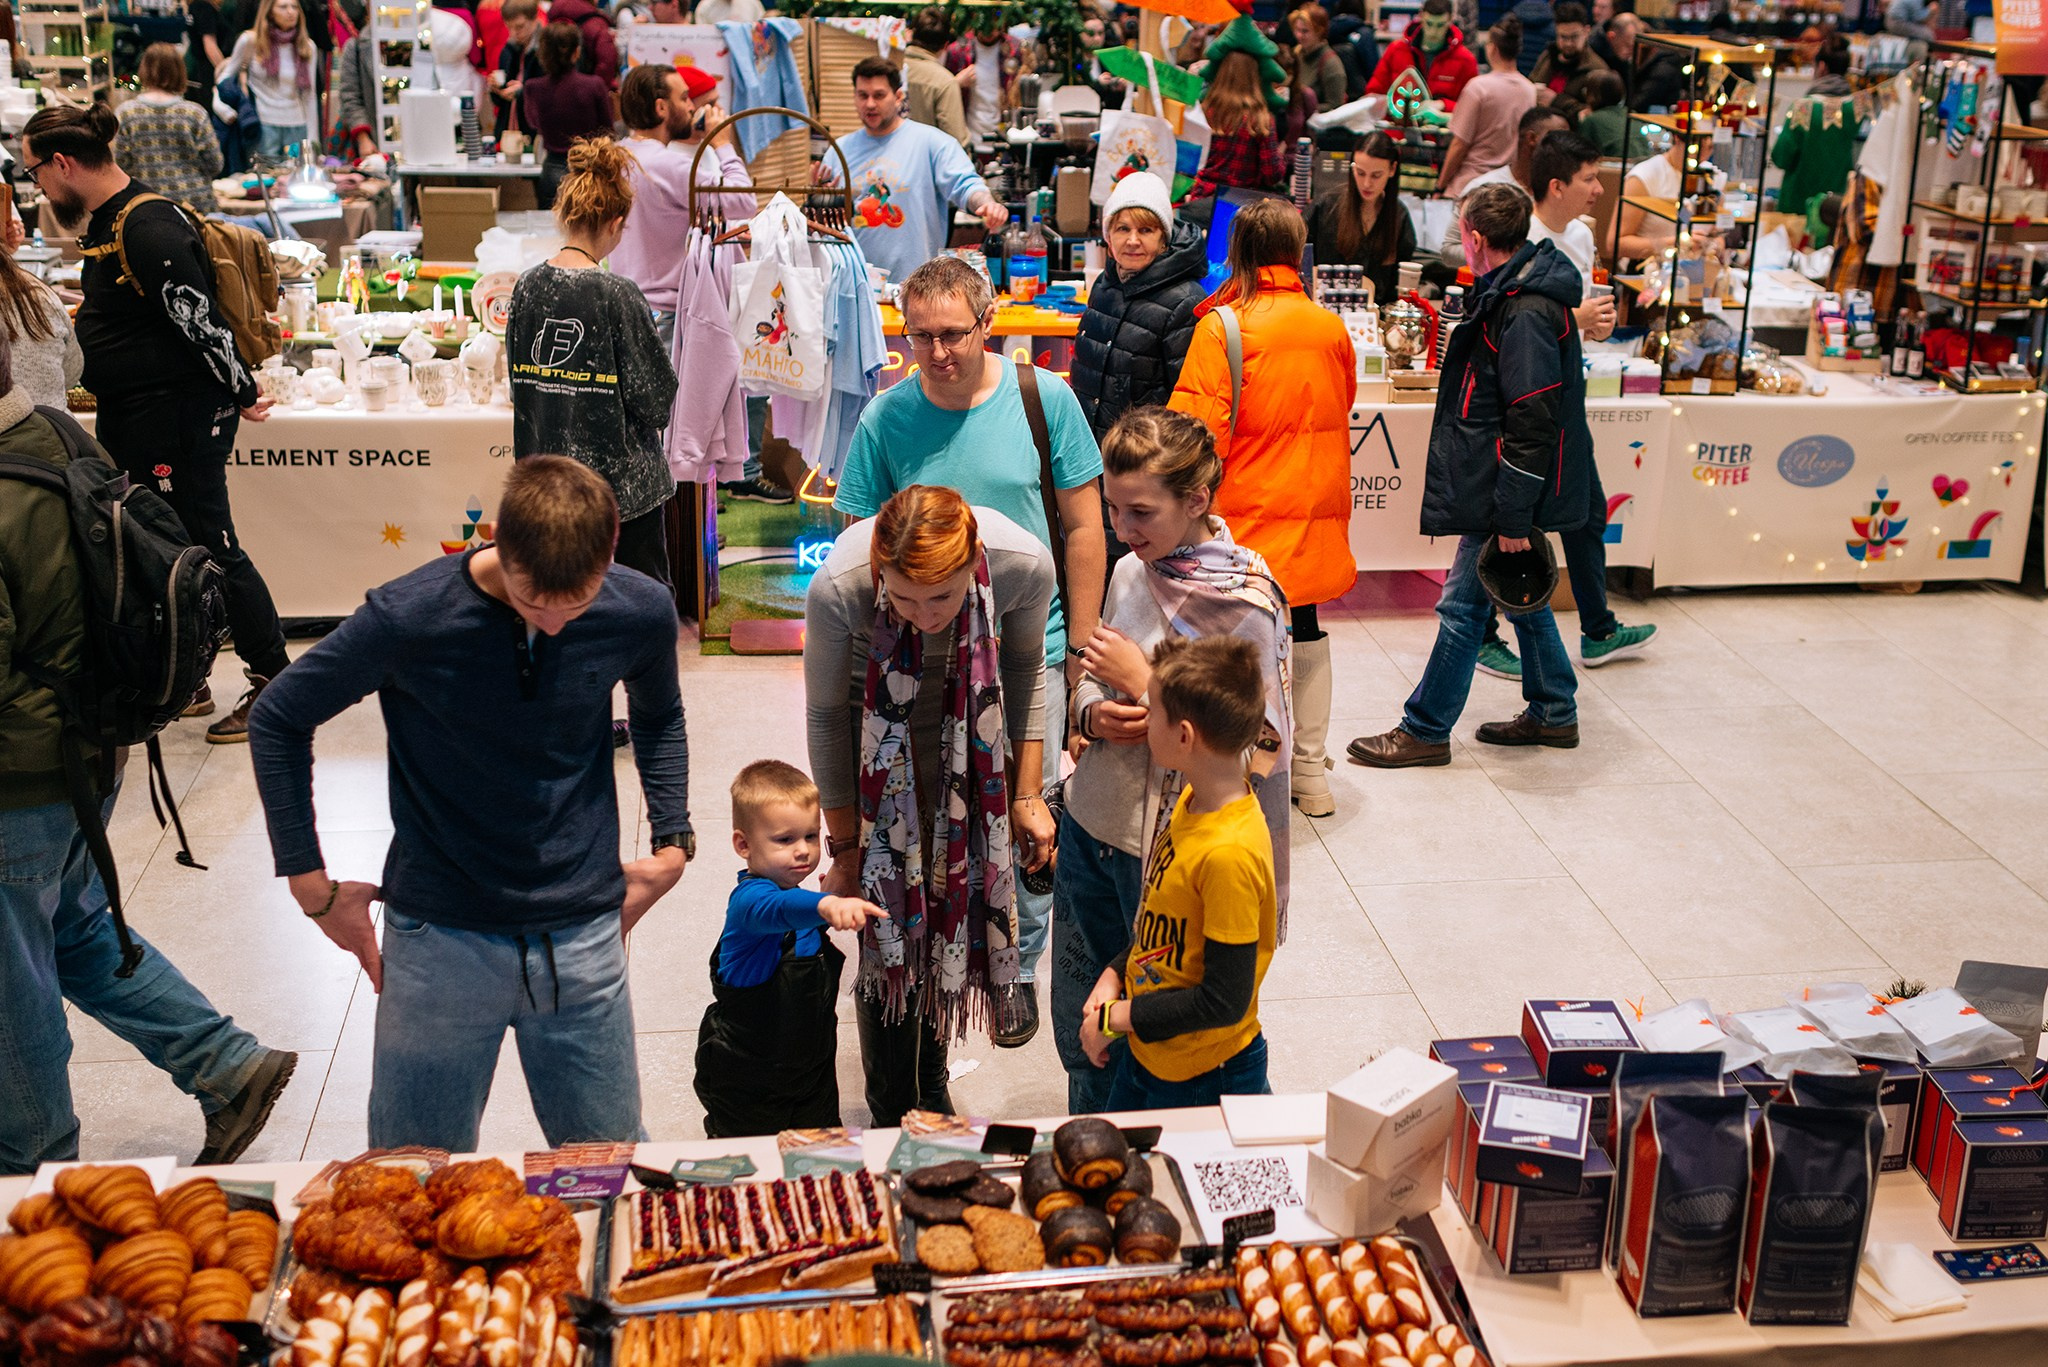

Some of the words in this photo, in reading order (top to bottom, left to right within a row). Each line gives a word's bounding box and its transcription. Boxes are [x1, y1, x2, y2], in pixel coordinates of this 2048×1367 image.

[541, 367, 591, 381] STUDIO
[1619, 410, 1652, 422] FEST
[1904, 432, 1940, 445] OPEN
[348, 449, 431, 466] SPACE
[1698, 442, 1752, 463] PITER
[1692, 465, 1750, 486] COFFEE
